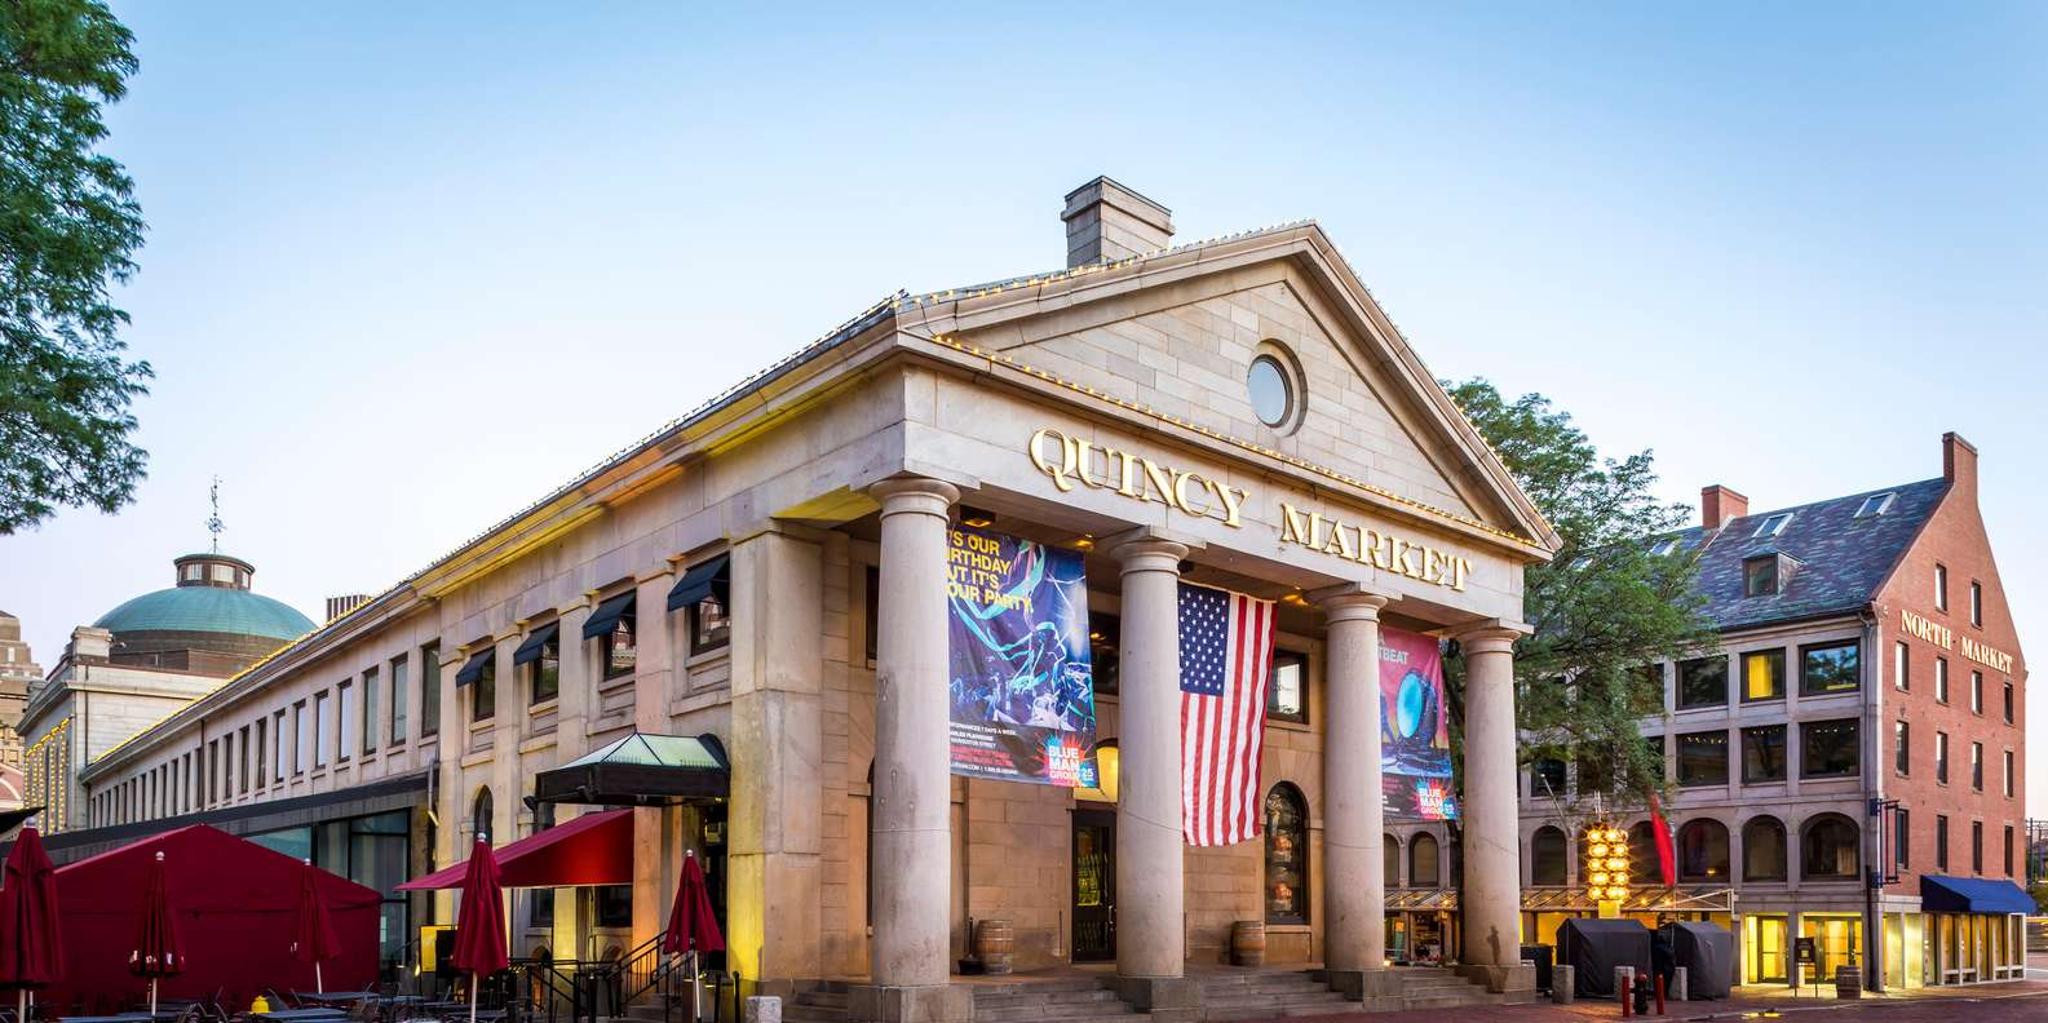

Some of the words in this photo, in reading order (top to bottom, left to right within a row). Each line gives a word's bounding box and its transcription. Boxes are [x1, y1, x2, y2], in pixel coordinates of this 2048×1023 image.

[1028, 426, 1250, 528] QUINCY
[1280, 502, 1474, 592] MARKET
[968, 535, 1000, 556] OUR
[972, 570, 999, 590] IT'S
[1901, 608, 1952, 650] NORTH
[1961, 636, 2013, 673] MARKET
[1049, 746, 1079, 758] BLUE
[1049, 758, 1080, 771] MAN
[1419, 788, 1441, 798] BLUE
